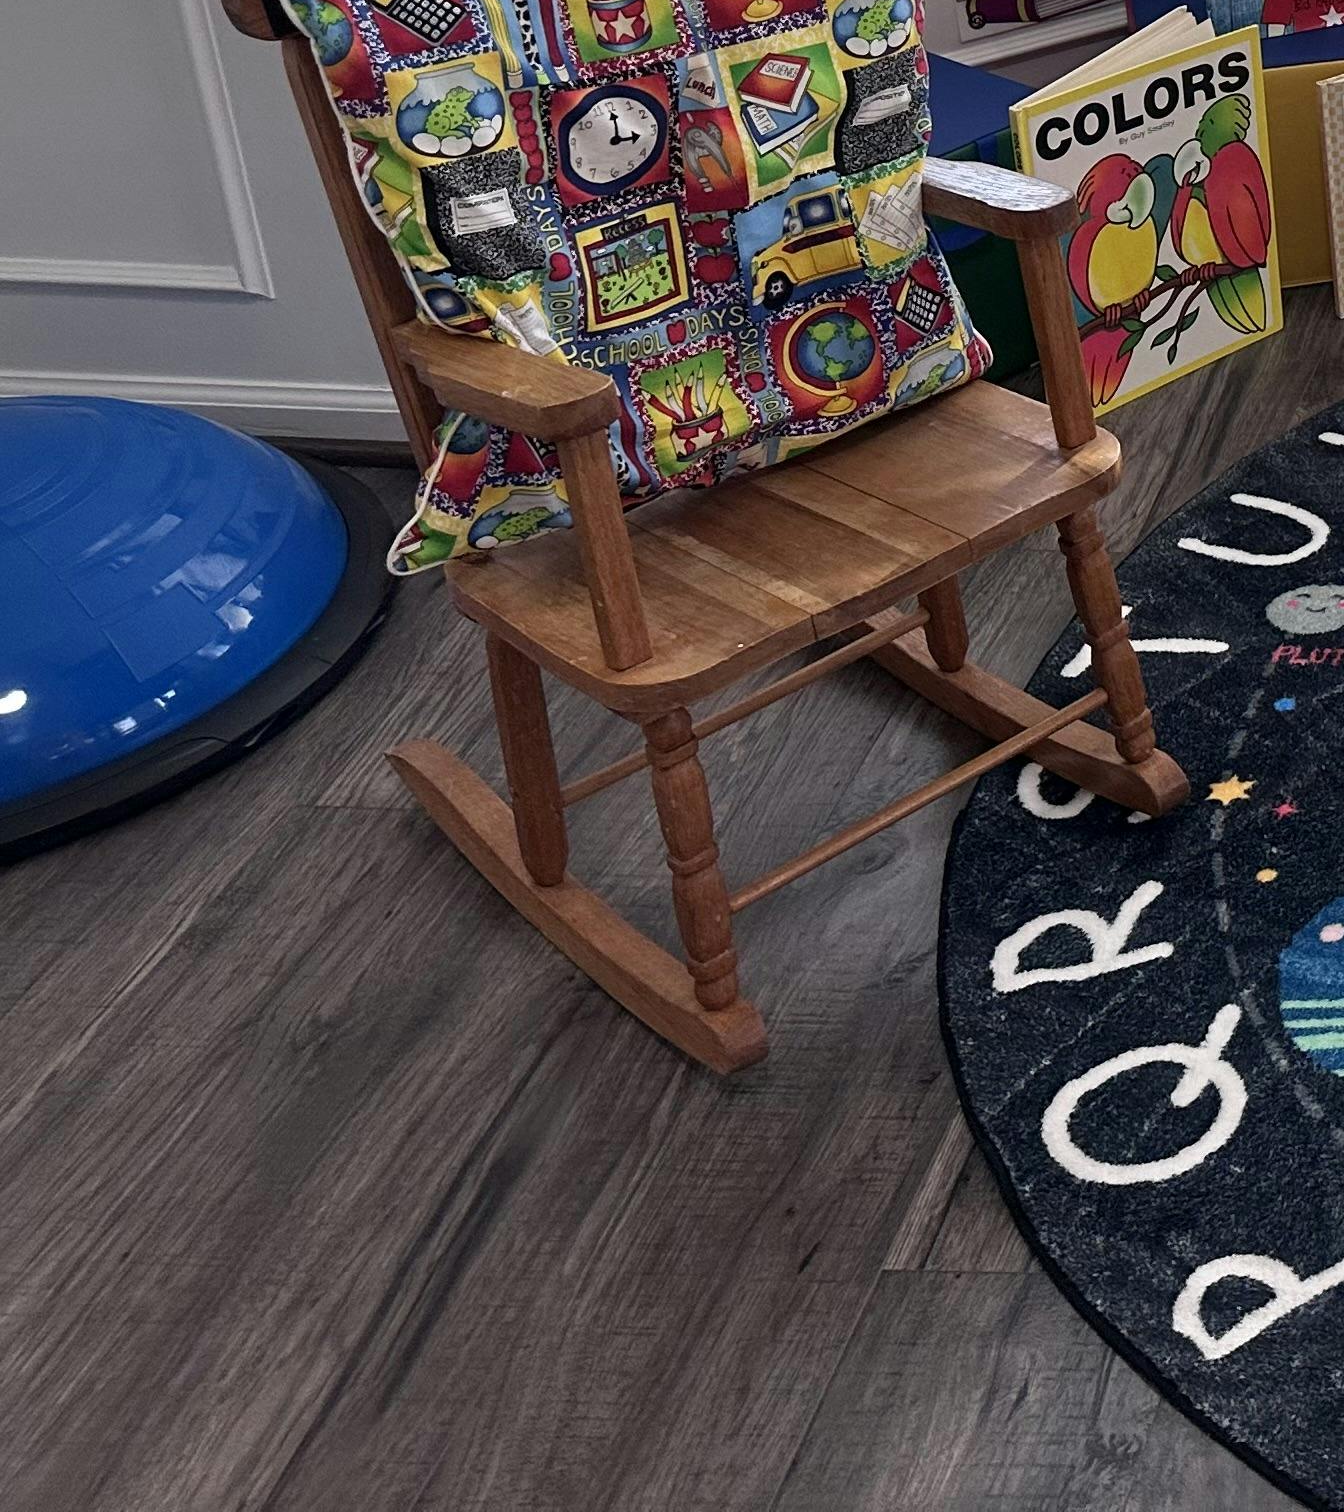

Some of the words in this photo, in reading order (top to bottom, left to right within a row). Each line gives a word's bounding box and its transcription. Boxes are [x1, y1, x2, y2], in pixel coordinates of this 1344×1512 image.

[639, 109, 649, 120] 2
[1035, 51, 1251, 162] COLORS
[578, 120, 592, 131] 10
[751, 104, 774, 133] MATH
[650, 124, 657, 136] 3
[575, 157, 583, 169] 8
[639, 147, 648, 158] 4
[588, 167, 597, 180] 7
[610, 167, 620, 179] 6
[626, 160, 636, 172] 5
[526, 185, 564, 252] DAYS
[580, 330, 666, 370] SCHOOL
[686, 306, 745, 338] DAYS
[739, 328, 764, 373] DAYS
[1177, 493, 1330, 567] U
[990, 880, 1175, 994] R
[1041, 1003, 1248, 1185] Q
